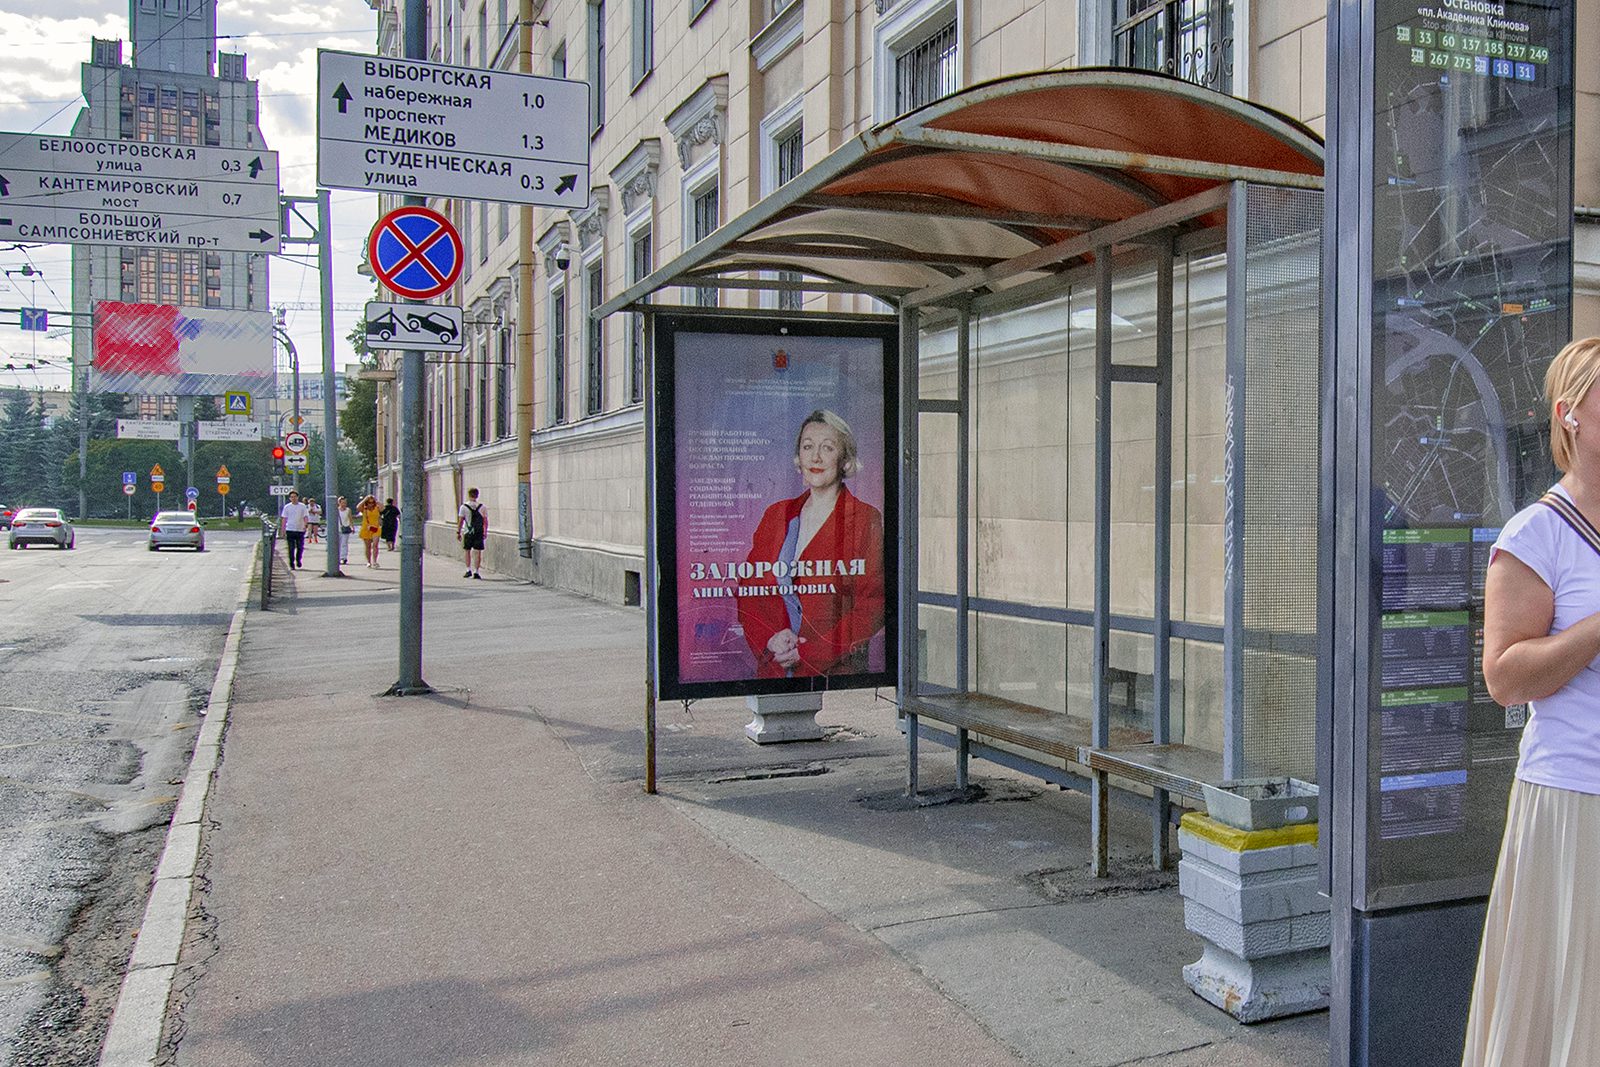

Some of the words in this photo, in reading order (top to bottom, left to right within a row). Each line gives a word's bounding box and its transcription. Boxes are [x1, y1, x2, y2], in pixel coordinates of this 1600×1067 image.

[1443, 0, 1505, 16] Остановка
[1417, 7, 1436, 18] «пл.
[1437, 8, 1485, 26] Академика
[1487, 17, 1530, 32] Климова»
[1422, 18, 1440, 31] Stop
[1419, 31, 1432, 44] 33
[1442, 35, 1455, 48] 60
[1462, 38, 1480, 51] 137
[1485, 42, 1503, 55] 185
[1507, 45, 1526, 58] 237
[1530, 48, 1548, 61] 249
[365, 61, 491, 90] ВЫБОРГСКАЯ
[1430, 52, 1449, 66] 267
[1453, 56, 1472, 69] 275
[1496, 63, 1509, 75] 18
[1519, 66, 1531, 78] 31
[365, 86, 472, 109] набережная
[522, 93, 545, 110] 1,0
[365, 107, 446, 126] проспект
[365, 124, 456, 147] МЕДИКОВ
[522, 134, 544, 151] 1,3
[39, 139, 196, 161] БЕЛООСТРОВСКАЯ
[96, 160, 142, 173] улица
[221, 160, 241, 174] 0,3
[365, 148, 512, 177] СТУДЕНЧЕСКАЯ
[39, 177, 199, 197] КАНТЕМИРОВСКИЙ
[365, 171, 417, 187] улица
[520, 174, 545, 191] 0,3
[102, 198, 139, 208] мост
[222, 193, 242, 206] 0,7
[79, 212, 162, 229] БОЛЬШОЙ
[18, 224, 180, 245] САМПСОНИЕВСКИЙ
[188, 236, 219, 248] пр-т
[690, 559, 867, 583] ЗАДОРОЖНАЯ
[692, 586, 735, 599] АННА
[738, 583, 837, 597] ВИКТОРОВНА
